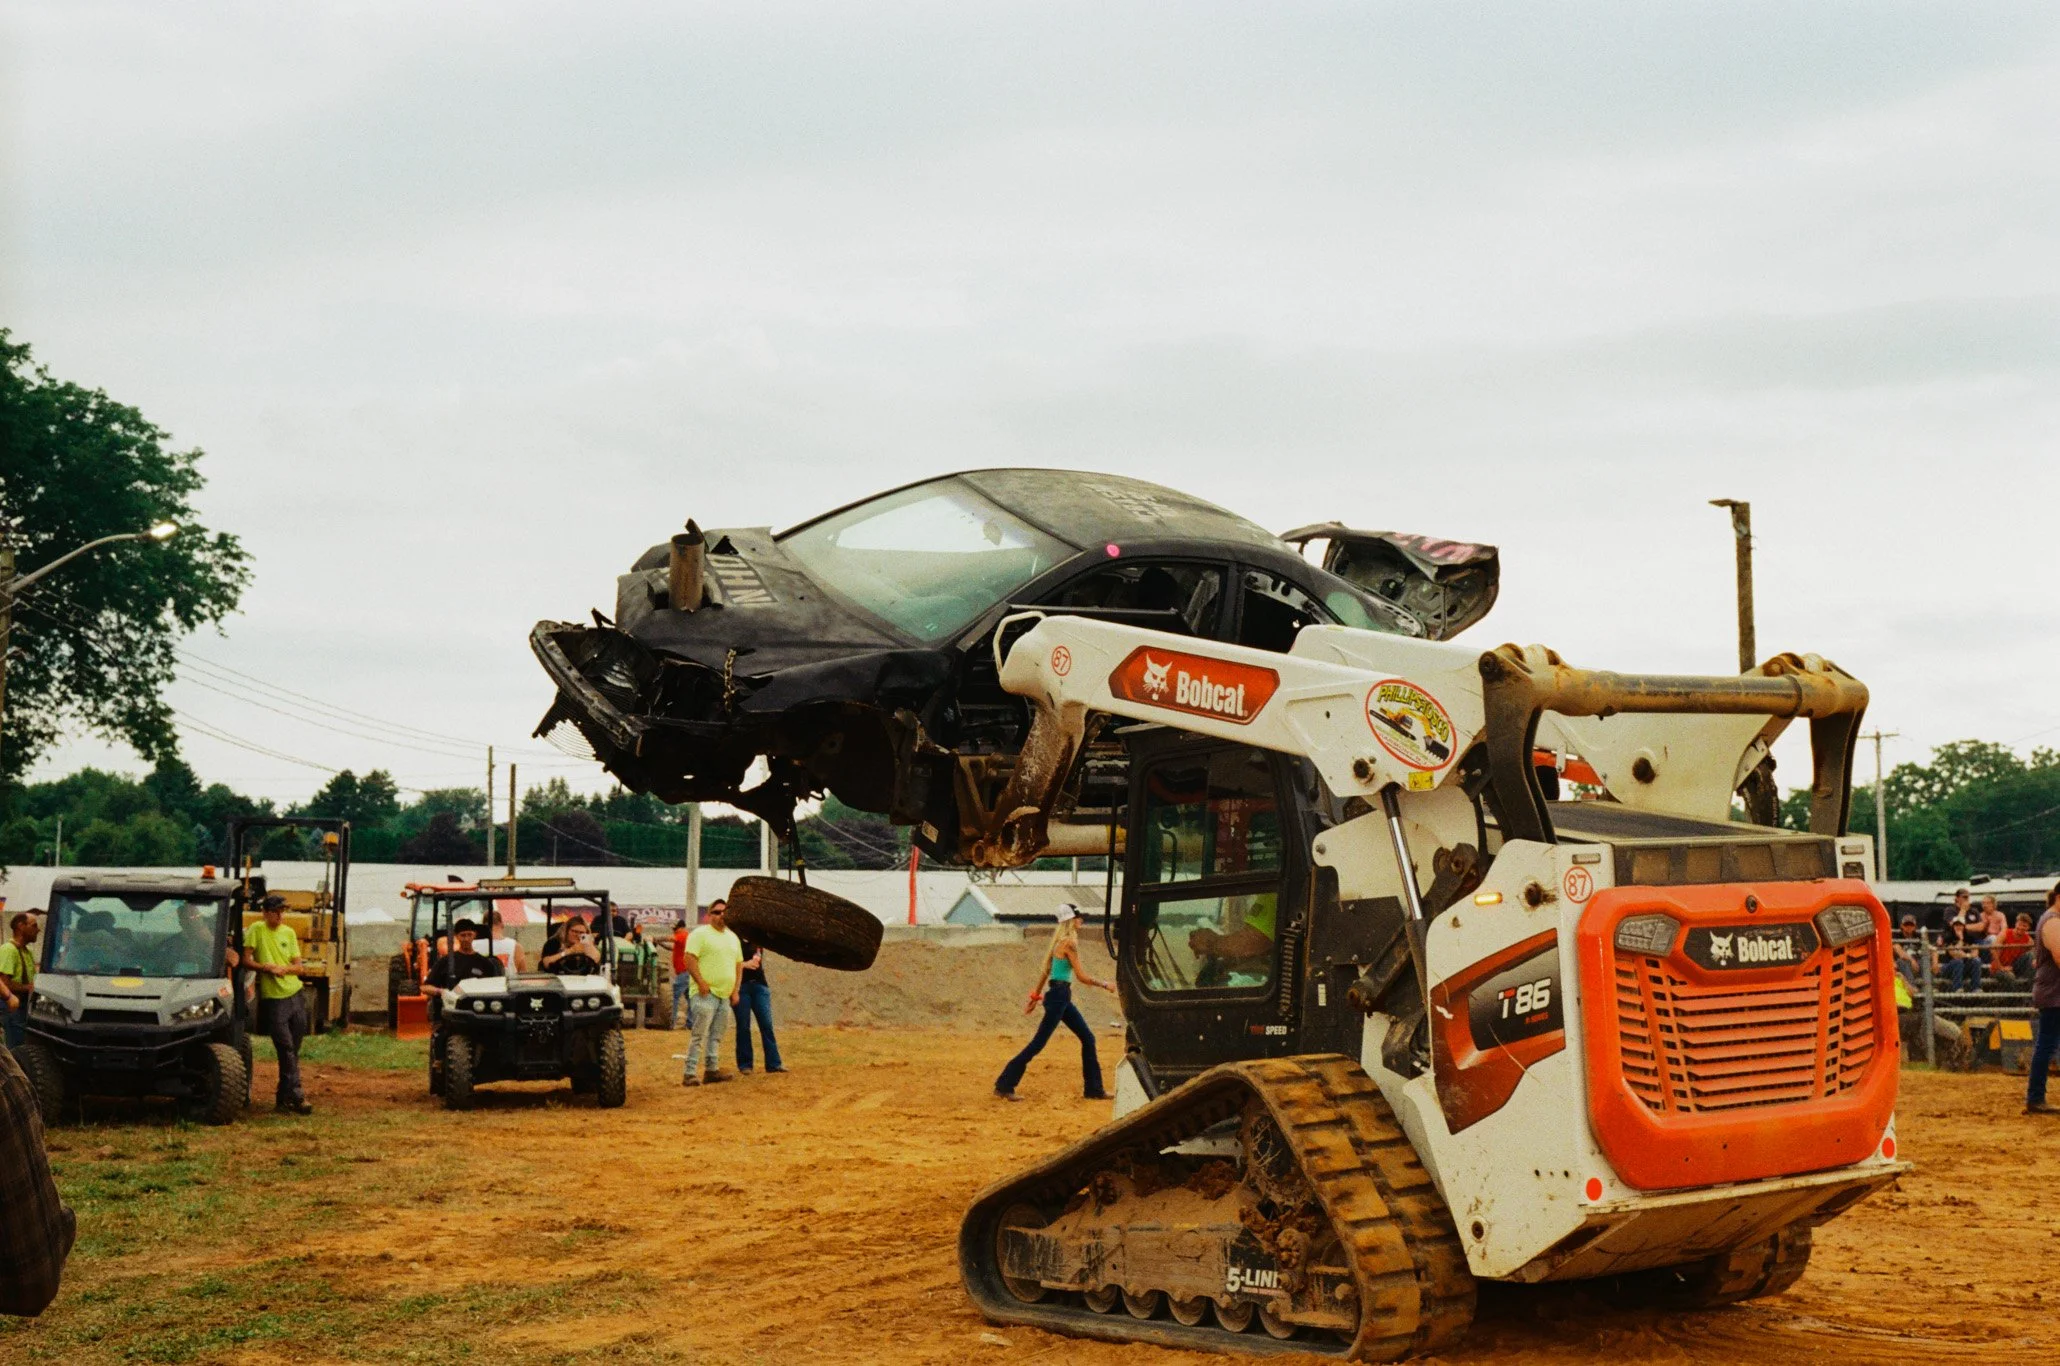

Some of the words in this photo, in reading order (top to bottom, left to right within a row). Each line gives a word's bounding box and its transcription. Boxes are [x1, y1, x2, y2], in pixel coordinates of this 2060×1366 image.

[1176, 670, 1245, 717] Bobcat
[1568, 874, 1587, 896] 87
[1737, 935, 1794, 962] Bobcat
[1498, 978, 1551, 1019] T86
[1265, 1025, 1288, 1036] SPEED
